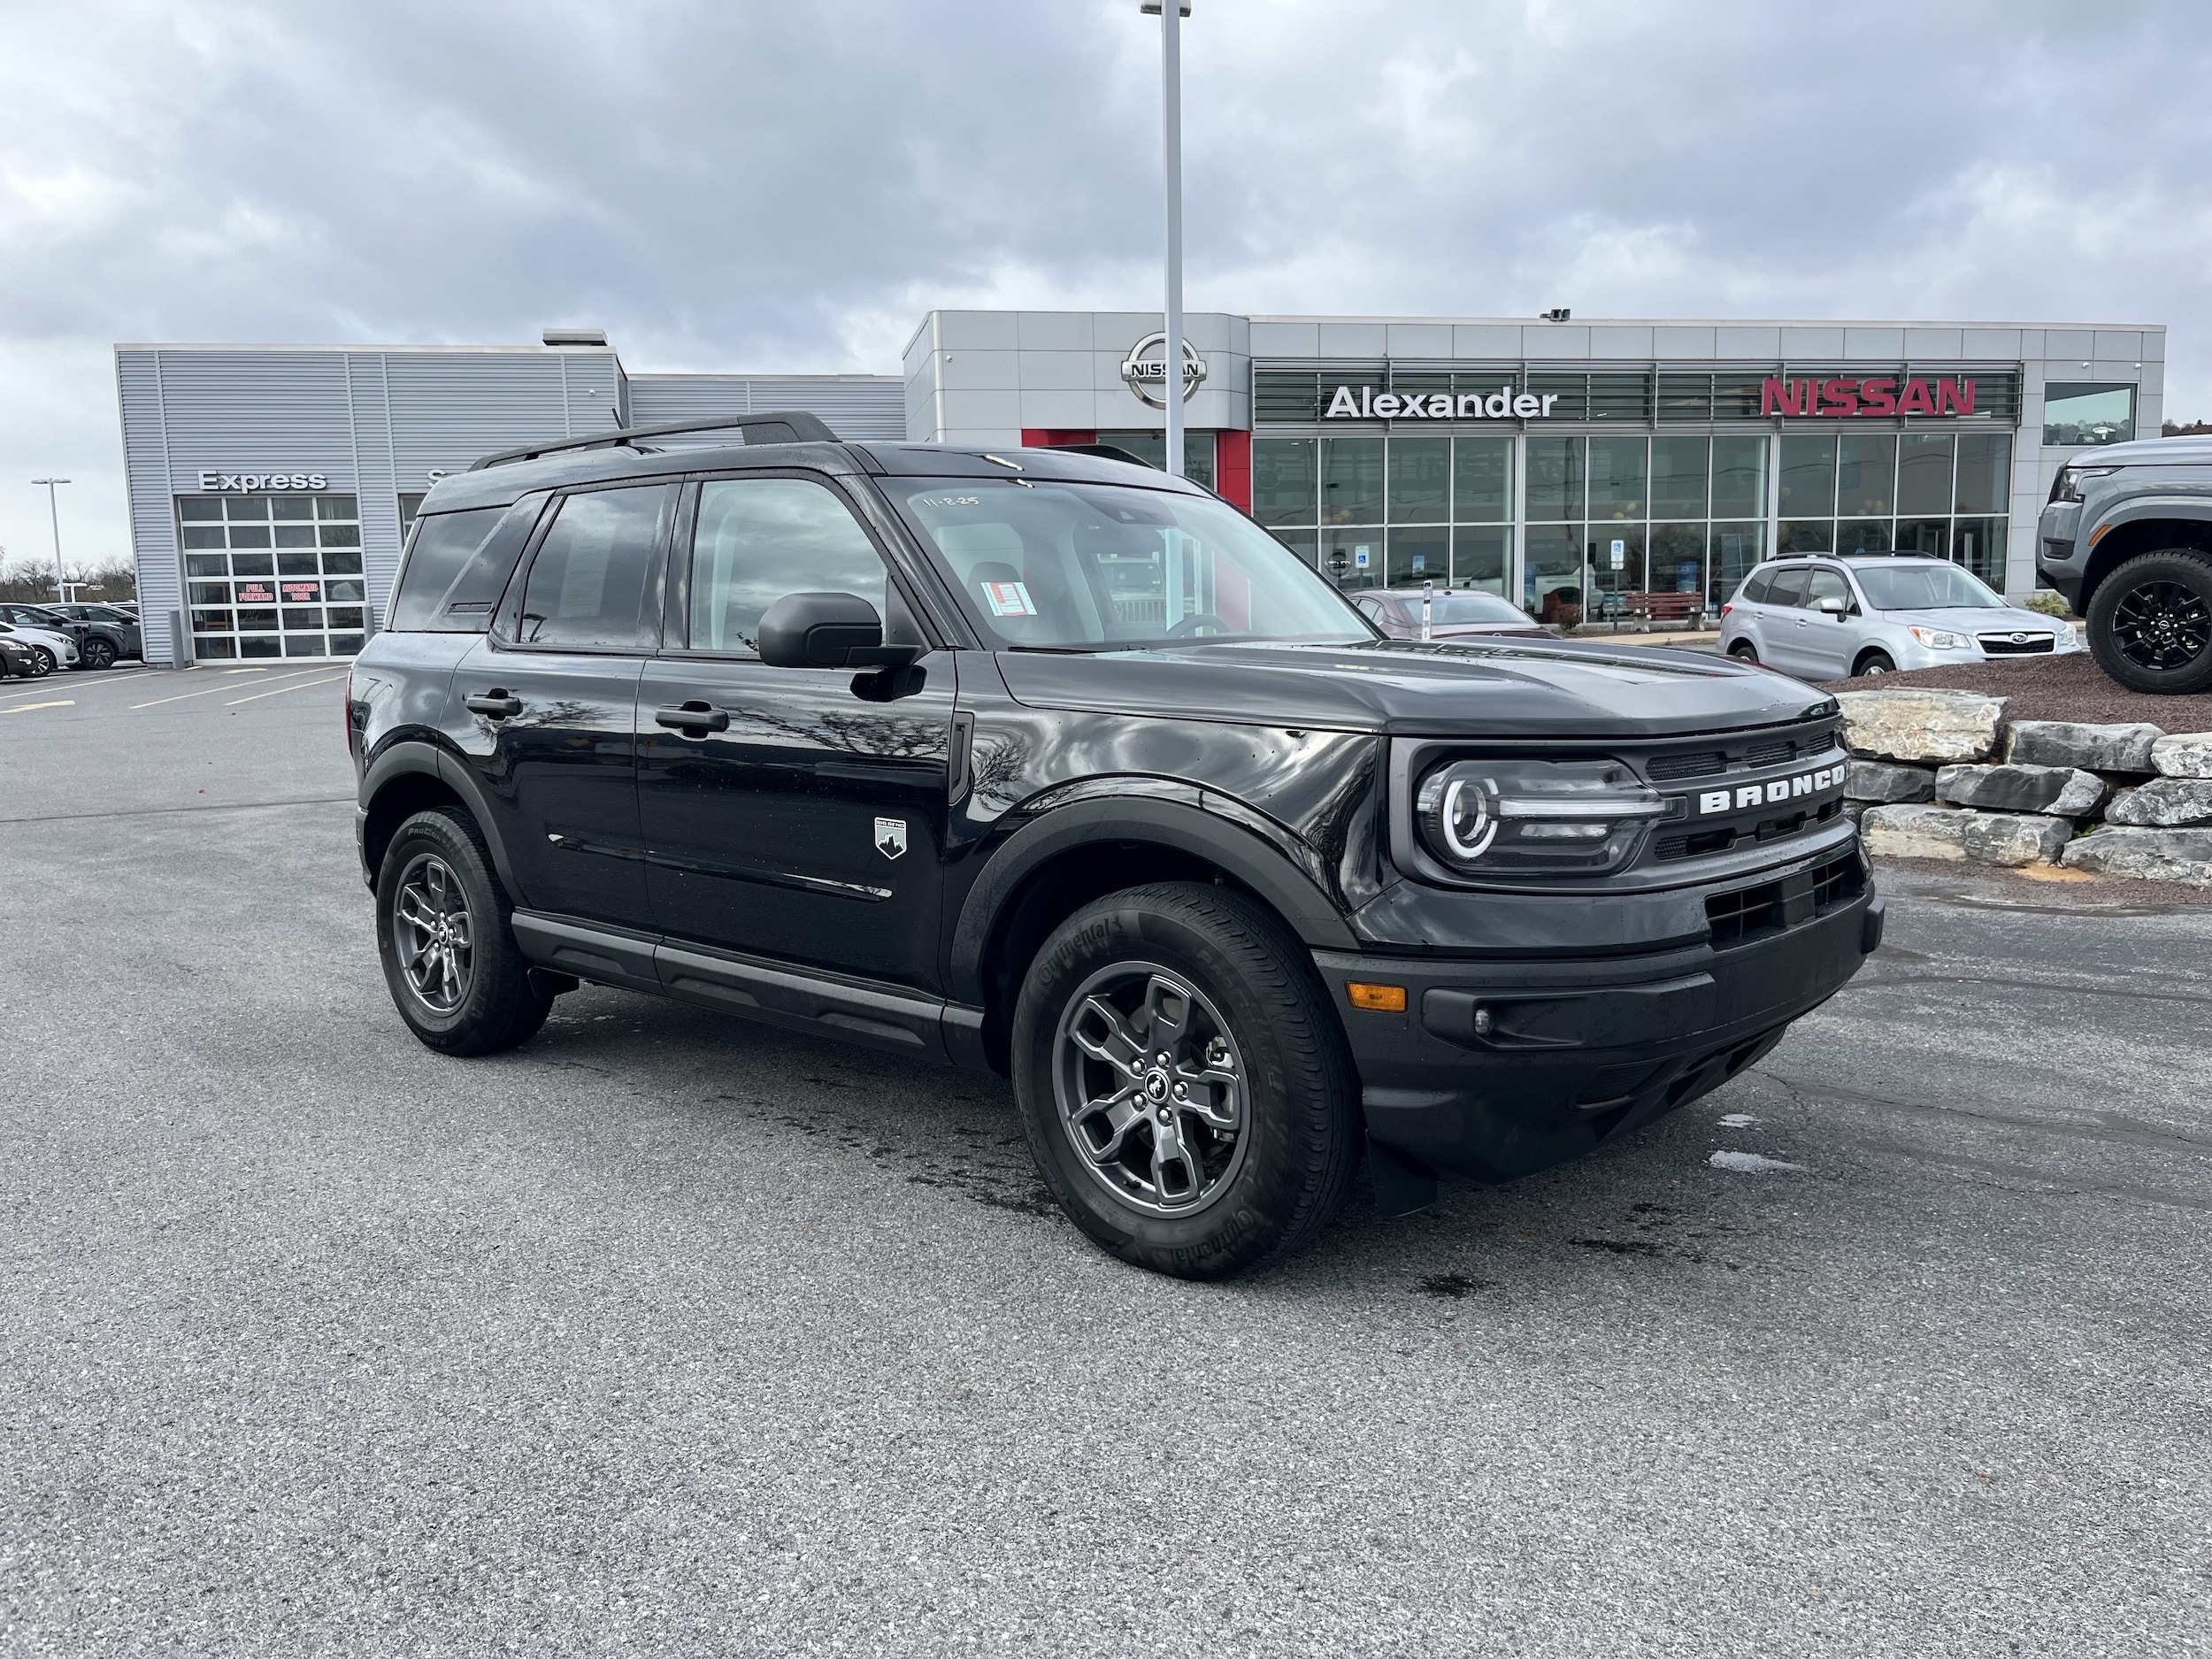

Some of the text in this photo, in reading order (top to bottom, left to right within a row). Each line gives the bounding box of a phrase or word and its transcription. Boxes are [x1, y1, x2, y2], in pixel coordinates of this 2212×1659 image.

[1131, 363, 1199, 377] NISN
[1325, 386, 1558, 419] Alexander
[1761, 379, 1975, 416] NISSAN
[197, 470, 327, 494] Express
[923, 496, 979, 508] 11-8-25
[245, 583, 265, 593] PULL
[281, 583, 319, 593] AUTOMATIC
[238, 592, 274, 602] FORWARD
[291, 592, 311, 601] DOOR
[1699, 764, 1846, 815] BRONCO
